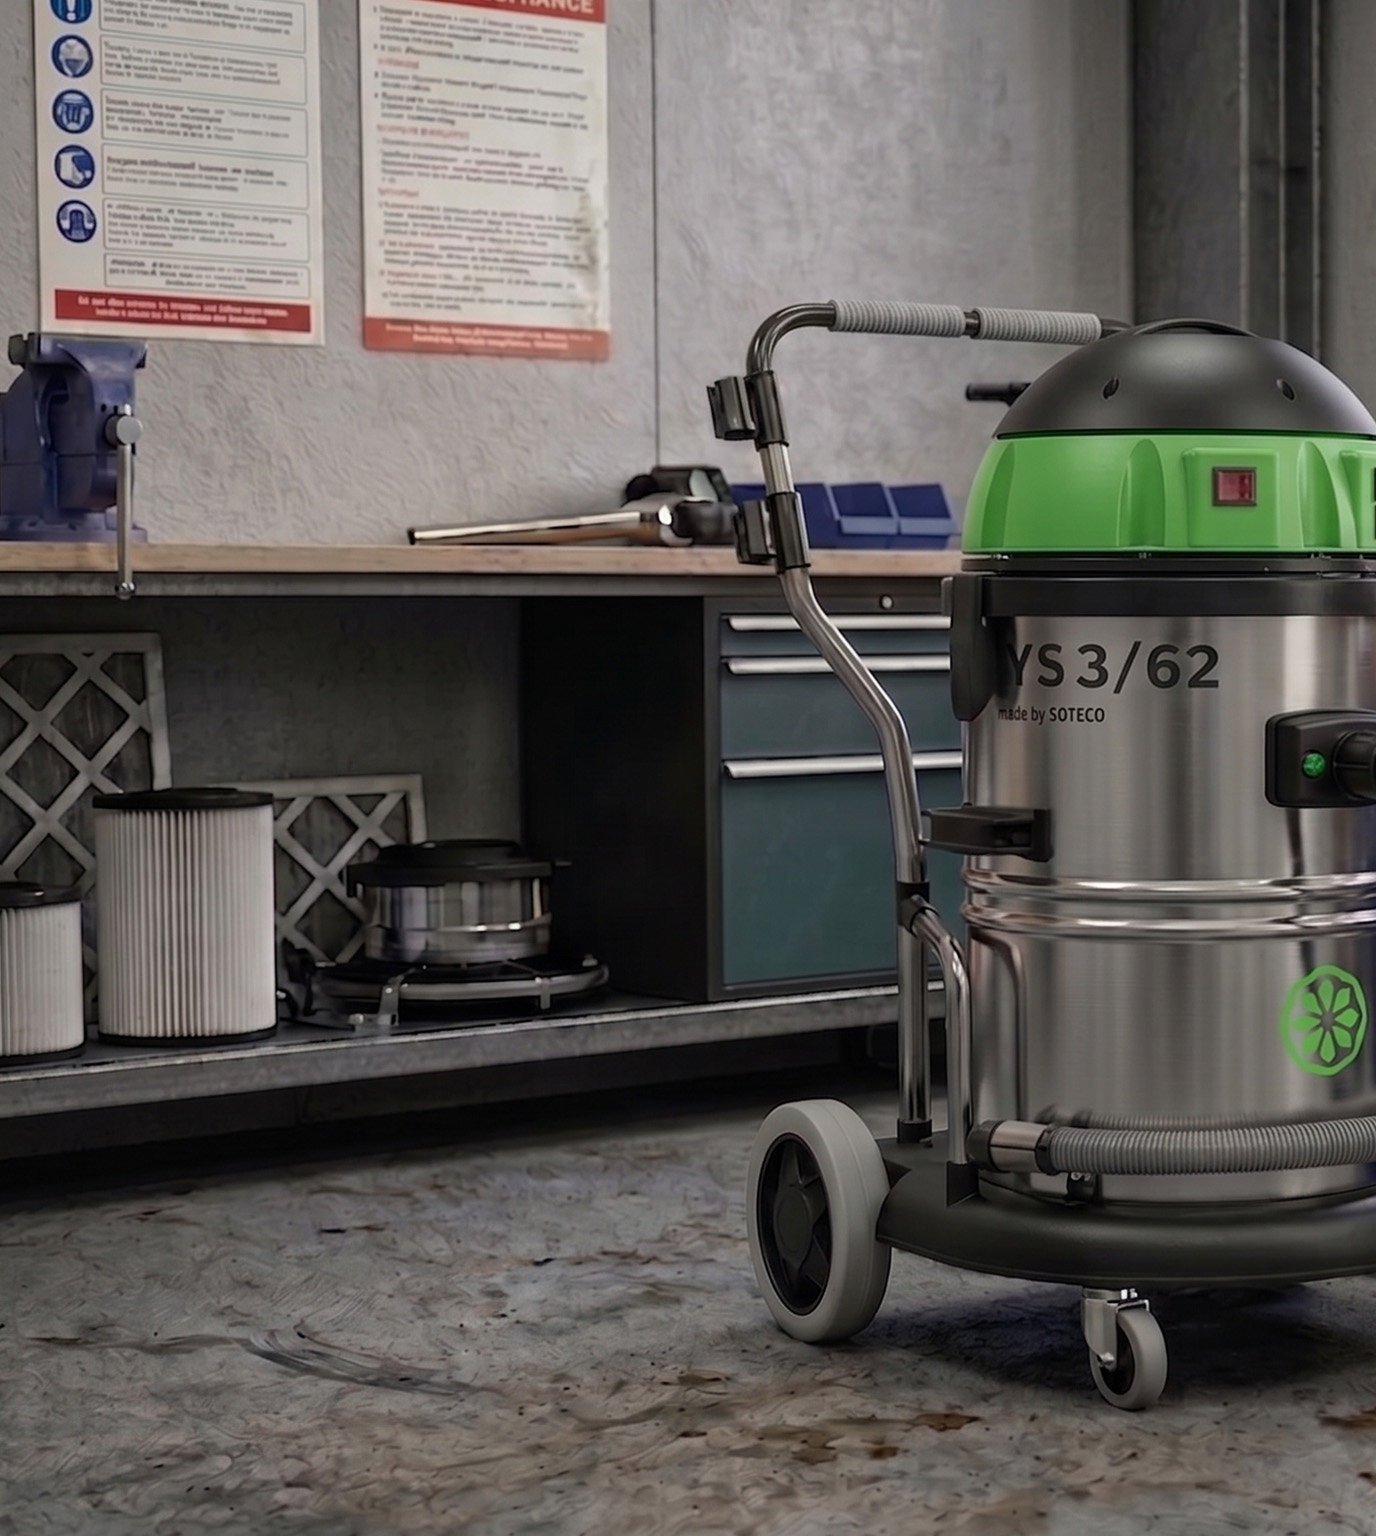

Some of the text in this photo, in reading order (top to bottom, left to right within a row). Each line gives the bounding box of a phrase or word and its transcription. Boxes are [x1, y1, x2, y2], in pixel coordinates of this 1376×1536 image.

[1008, 641, 1219, 694] YS 3/62
[998, 706, 1105, 725] made by SOTECO
